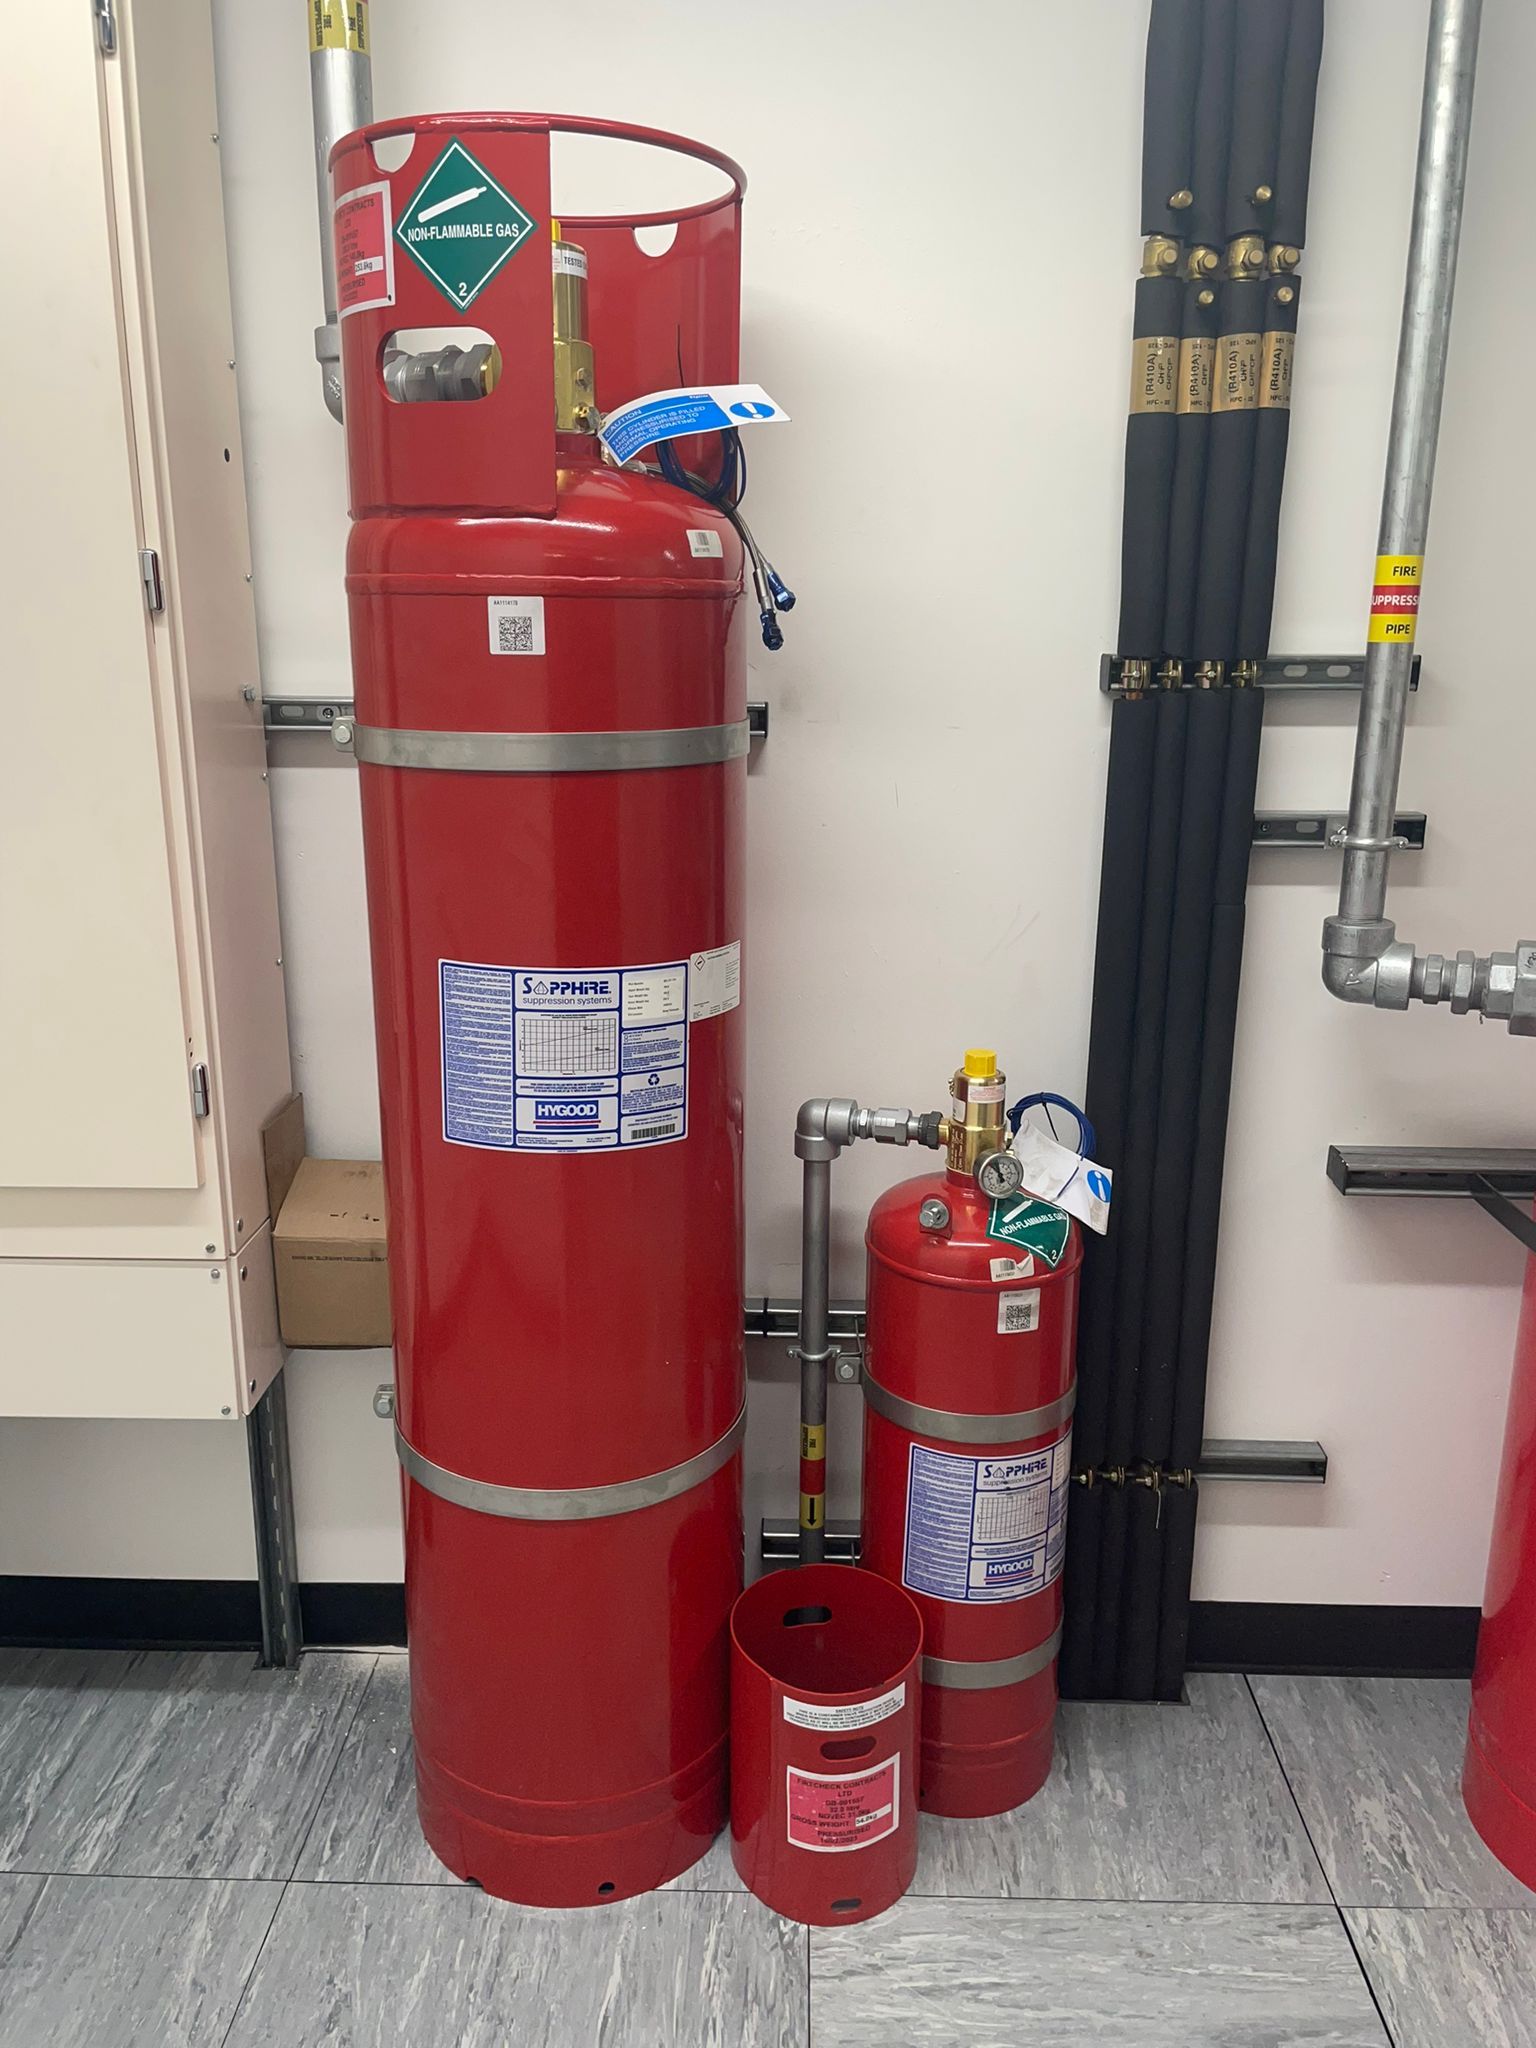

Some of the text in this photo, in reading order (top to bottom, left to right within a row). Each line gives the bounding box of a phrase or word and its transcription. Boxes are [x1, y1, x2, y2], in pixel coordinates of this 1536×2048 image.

[408, 222, 520, 242] NON-FLAMMABLE GAS
[564, 256, 583, 268] TESTED
[458, 282, 468, 297] 2
[1145, 353, 1158, 395] (R410A)
[1190, 353, 1202, 396] (R410A)
[1228, 350, 1240, 393] (R410A)
[1270, 347, 1284, 391] (R410A)
[604, 408, 642, 438] CAUTION
[612, 405, 706, 446] THIS CYLINDER IS FILLED
[615, 412, 700, 449] AND PRESSURISED TO
[617, 418, 697, 454] NORMAL OPERATING
[618, 430, 661, 458] PRESSURE
[1392, 565, 1417, 577] FIRE
[1385, 623, 1410, 634] PIPE
[522, 996, 612, 1006] suppression systems
[537, 1104, 597, 1117] HYGOOD
[999, 1213, 1055, 1236] NON-FLAMMABLE
[1051, 1249, 1057, 1260] 2
[988, 1557, 1033, 1576] HYGOOD
[842, 1770, 887, 1790] CONTRACTS
[837, 1790, 853, 1798] LTD
[790, 1813, 817, 1827] GROSS
[819, 1820, 850, 1828] WEIGHT
[816, 1824, 871, 1838] PRESSURISED
